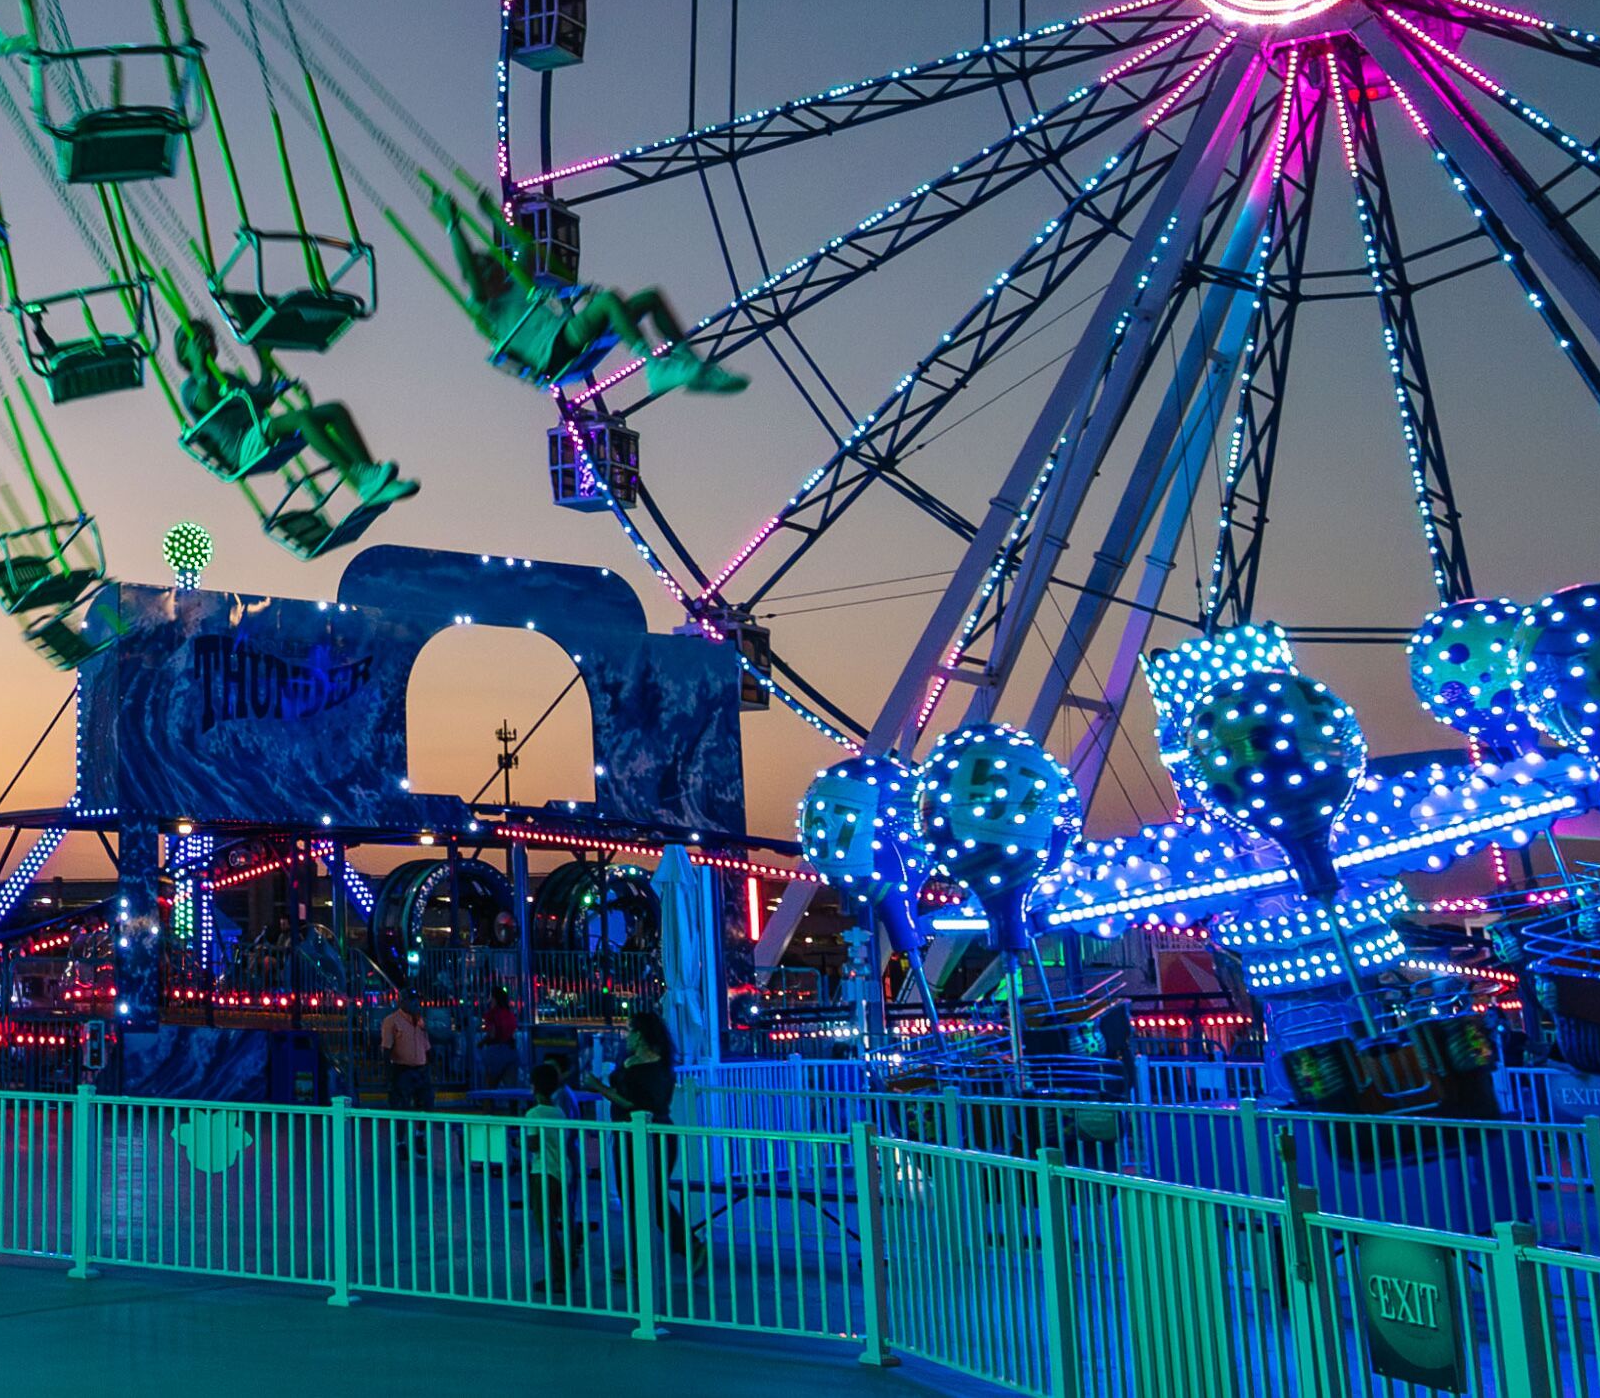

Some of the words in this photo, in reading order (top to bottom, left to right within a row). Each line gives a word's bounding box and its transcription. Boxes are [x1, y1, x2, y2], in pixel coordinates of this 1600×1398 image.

[193, 634, 374, 734] THUNDER
[969, 757, 1049, 821] 57
[1559, 1087, 1600, 1106] EXIT
[1369, 1274, 1438, 1329] EXIT
